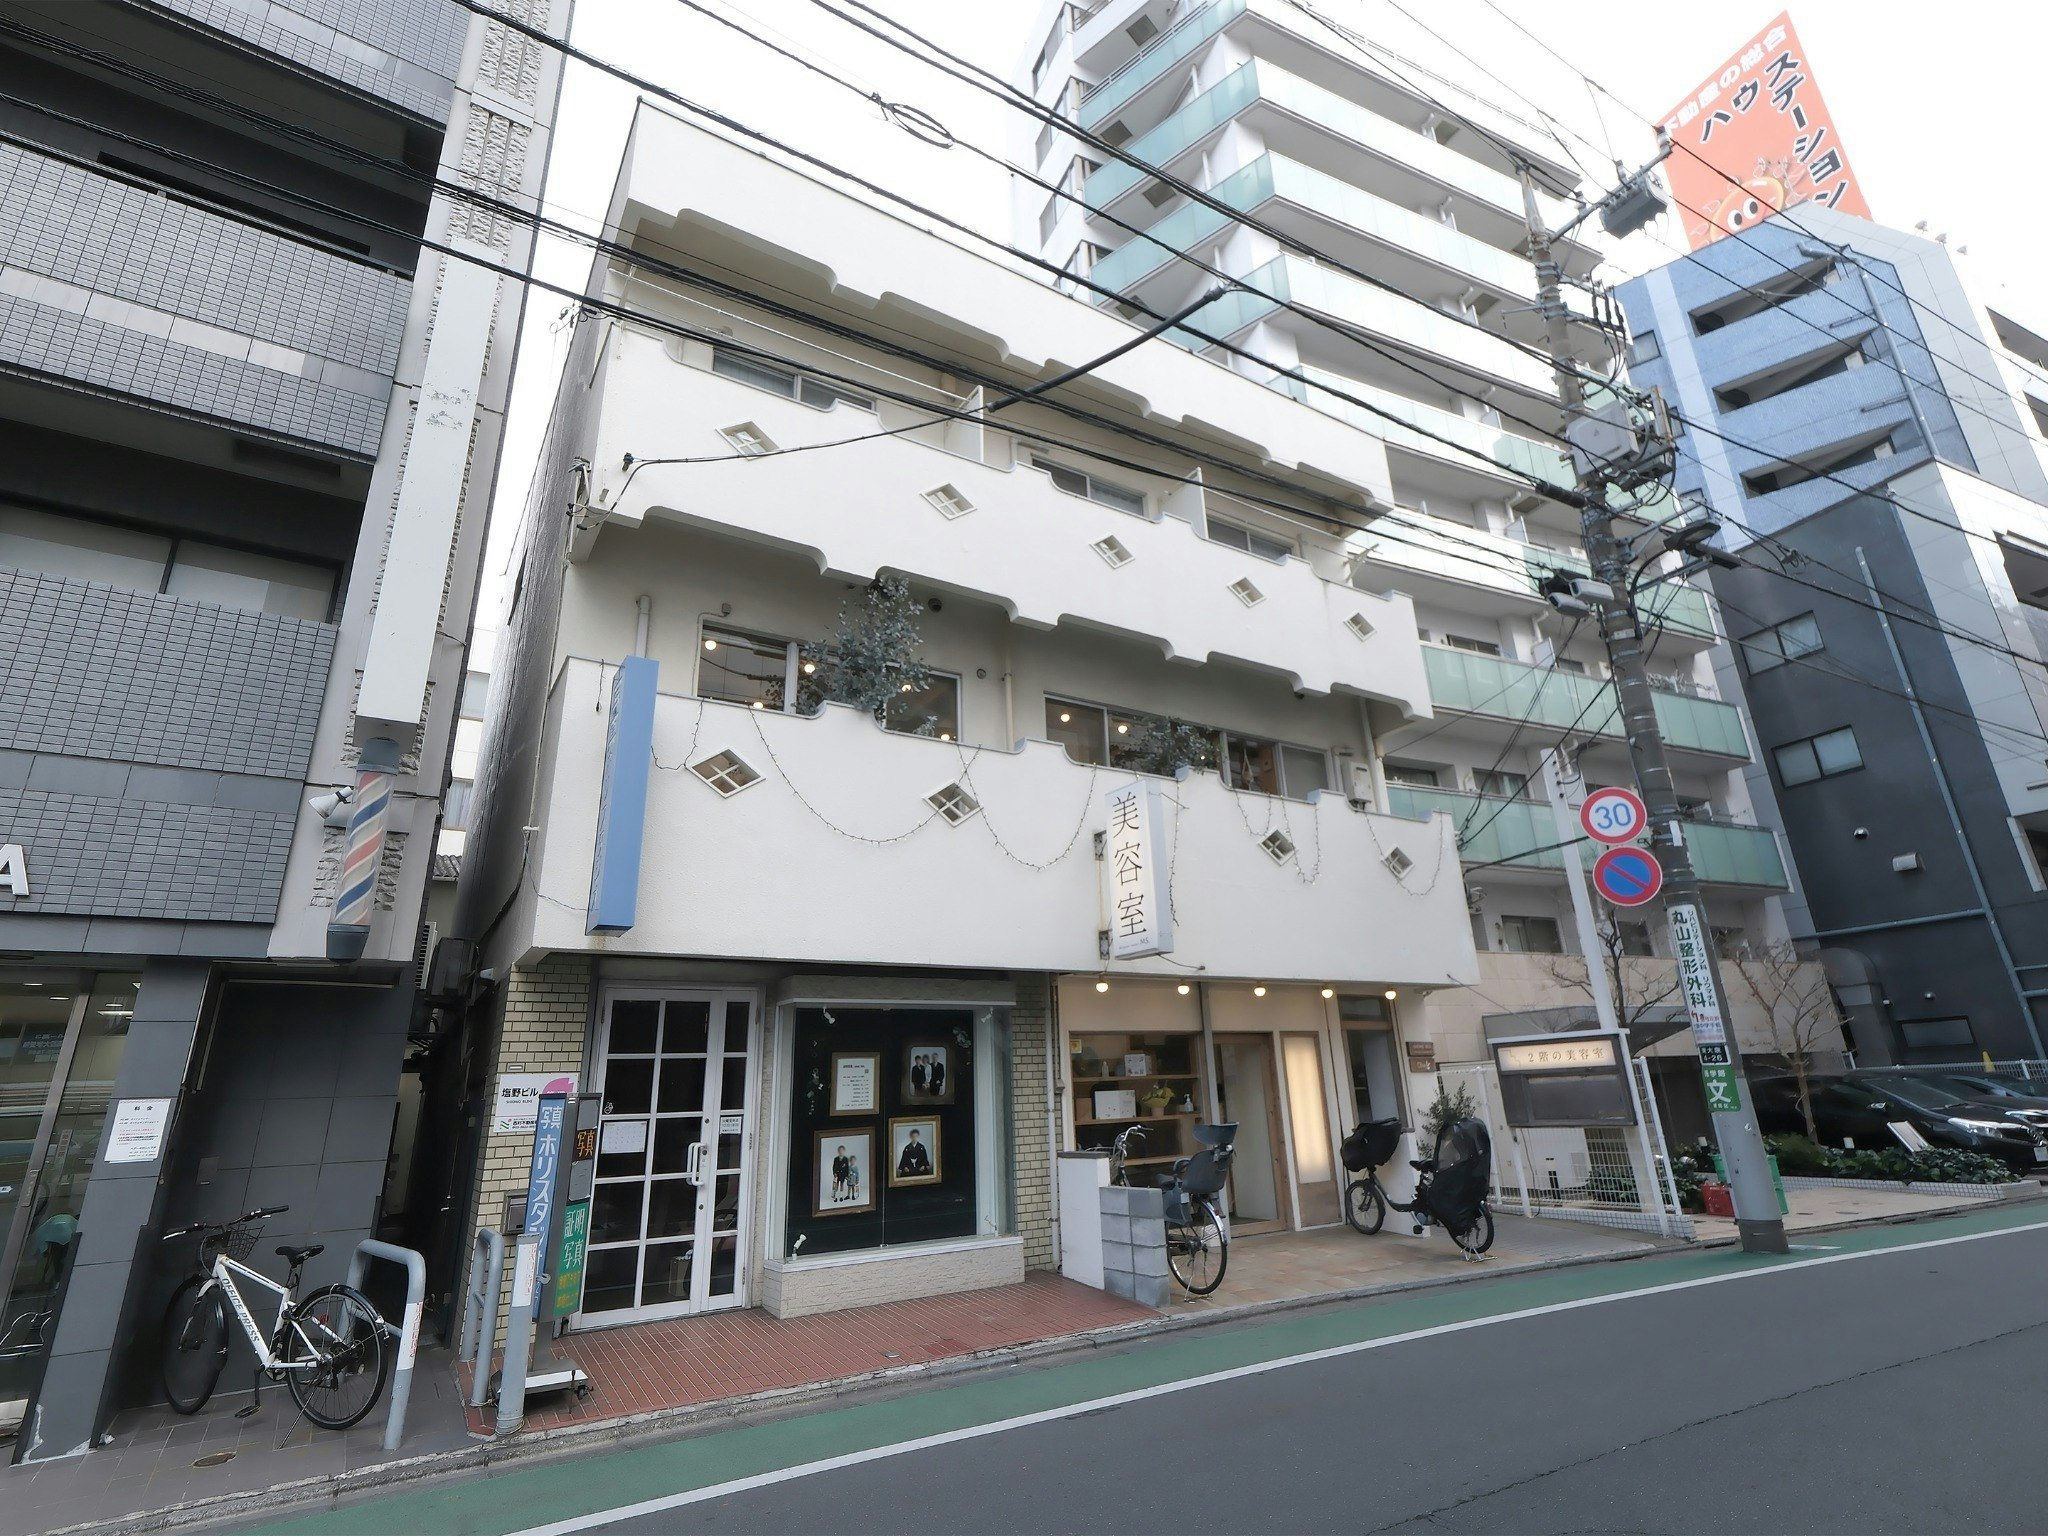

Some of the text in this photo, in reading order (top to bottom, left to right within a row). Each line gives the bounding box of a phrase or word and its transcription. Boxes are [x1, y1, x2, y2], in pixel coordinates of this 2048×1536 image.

[1595, 803, 1632, 829] 30
[1112, 791, 1147, 938] 美容室
[1672, 910, 1707, 1009] 丸山整形外科
[1527, 1046, 1605, 1063] 2階の美容室
[1703, 1054, 1723, 1062] 4-26
[502, 1087, 539, 1098] 塩野ビル
[221, 1278, 260, 1342] OFFICE PRESS
